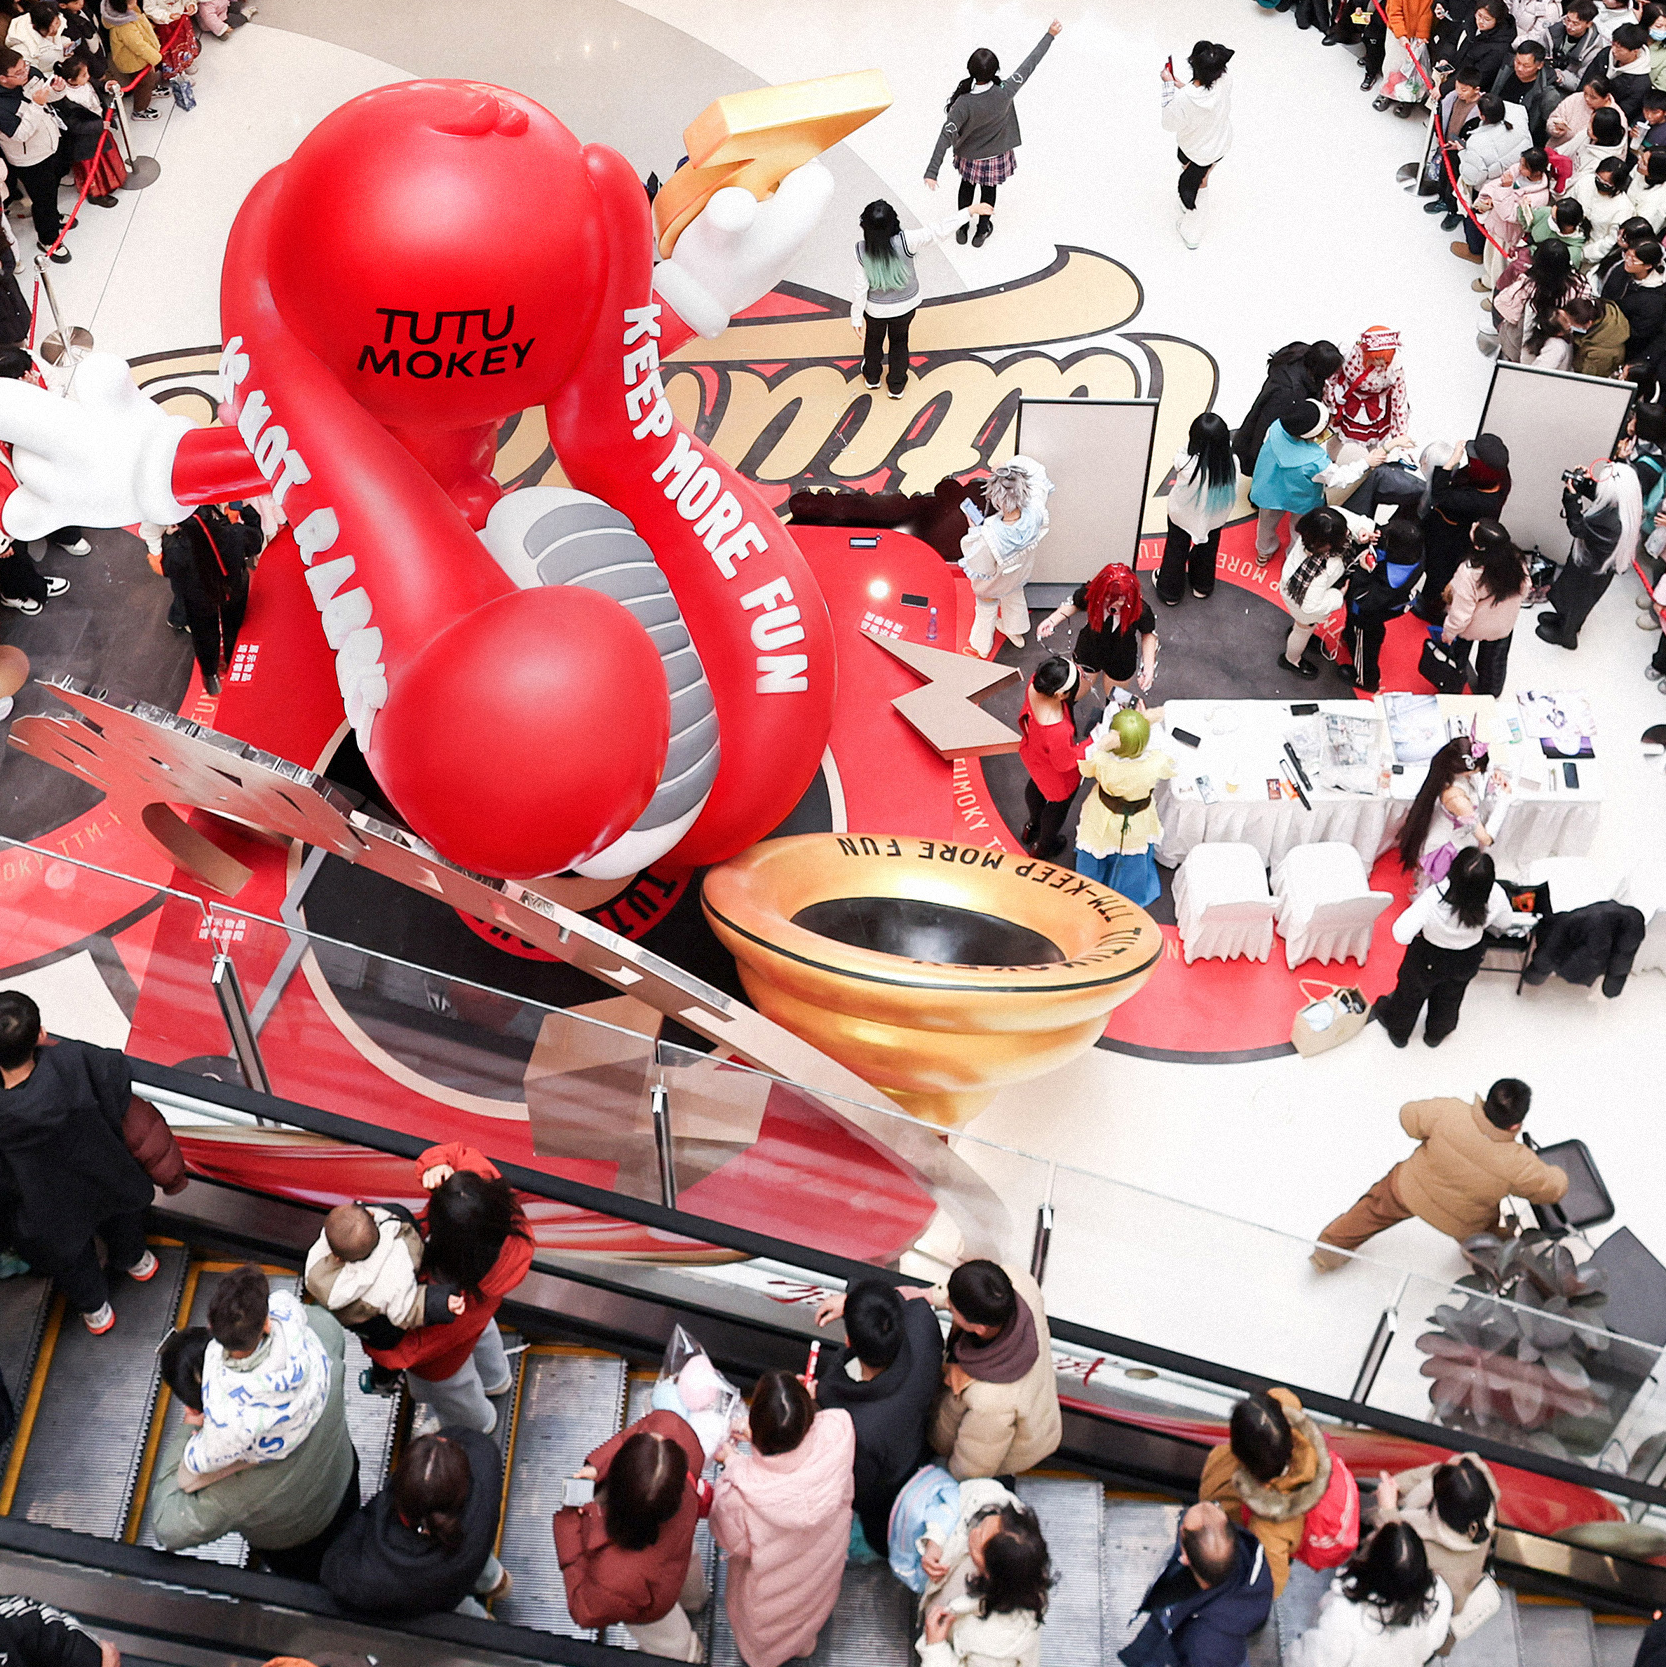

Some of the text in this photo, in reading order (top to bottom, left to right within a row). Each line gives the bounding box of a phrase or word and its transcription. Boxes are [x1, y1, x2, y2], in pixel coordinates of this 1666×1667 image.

[375, 304, 515, 345] TUTU
[357, 337, 536, 380] MOKEY
[623, 302, 809, 694] KEEP MORE FUN
[1216, 551, 1269, 583] MORE
[240, 643, 260, 682] 展示物品
[836, 837, 902, 858] FUN
[917, 840, 1006, 870] MORE
